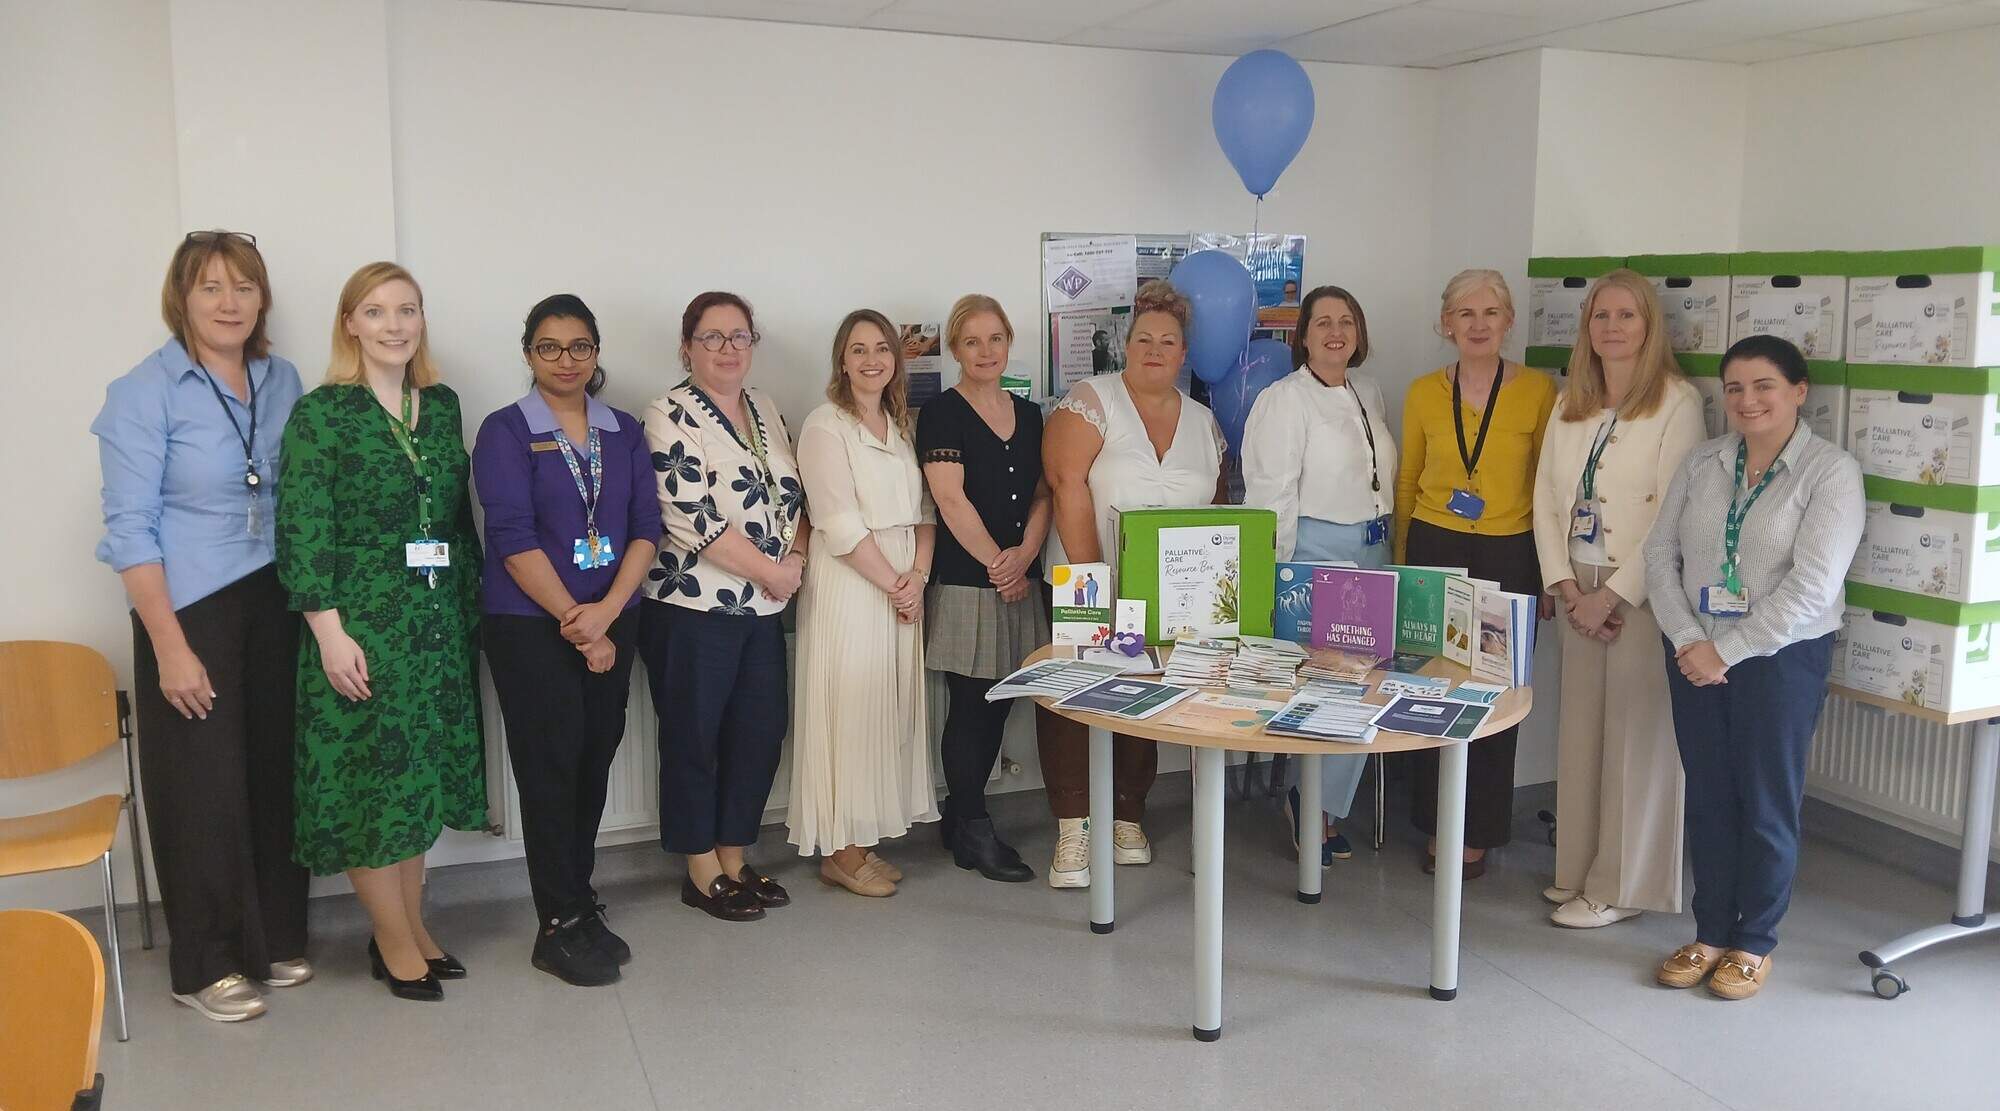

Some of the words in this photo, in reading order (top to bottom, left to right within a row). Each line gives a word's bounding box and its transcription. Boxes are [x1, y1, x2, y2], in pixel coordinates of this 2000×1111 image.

[1063, 274, 1082, 291] WP
[1753, 318, 1785, 326] PALLIATIVE
[1875, 320, 1913, 329] PALLIATIVE
[1875, 329, 1894, 337] CARE
[1872, 426, 1911, 437] PALLIATIVE
[1164, 549, 1203, 557] PALLIATIVE
[1872, 544, 1909, 556] PALLIATIVE
[1871, 552, 1889, 561] CARE
[1165, 563, 1197, 576] Resource
[1330, 623, 1372, 637] SOMETHING
[1402, 620, 1429, 632] ALWAYS
[1429, 623, 1437, 633] IN
[1326, 632, 1340, 643] HAS
[1342, 634, 1376, 647] CHANGED
[1402, 629, 1413, 639] MY
[1413, 630, 1436, 642] HEART
[1852, 641, 1892, 656] PALLIATIVE
[1852, 649, 1870, 660] CARE
